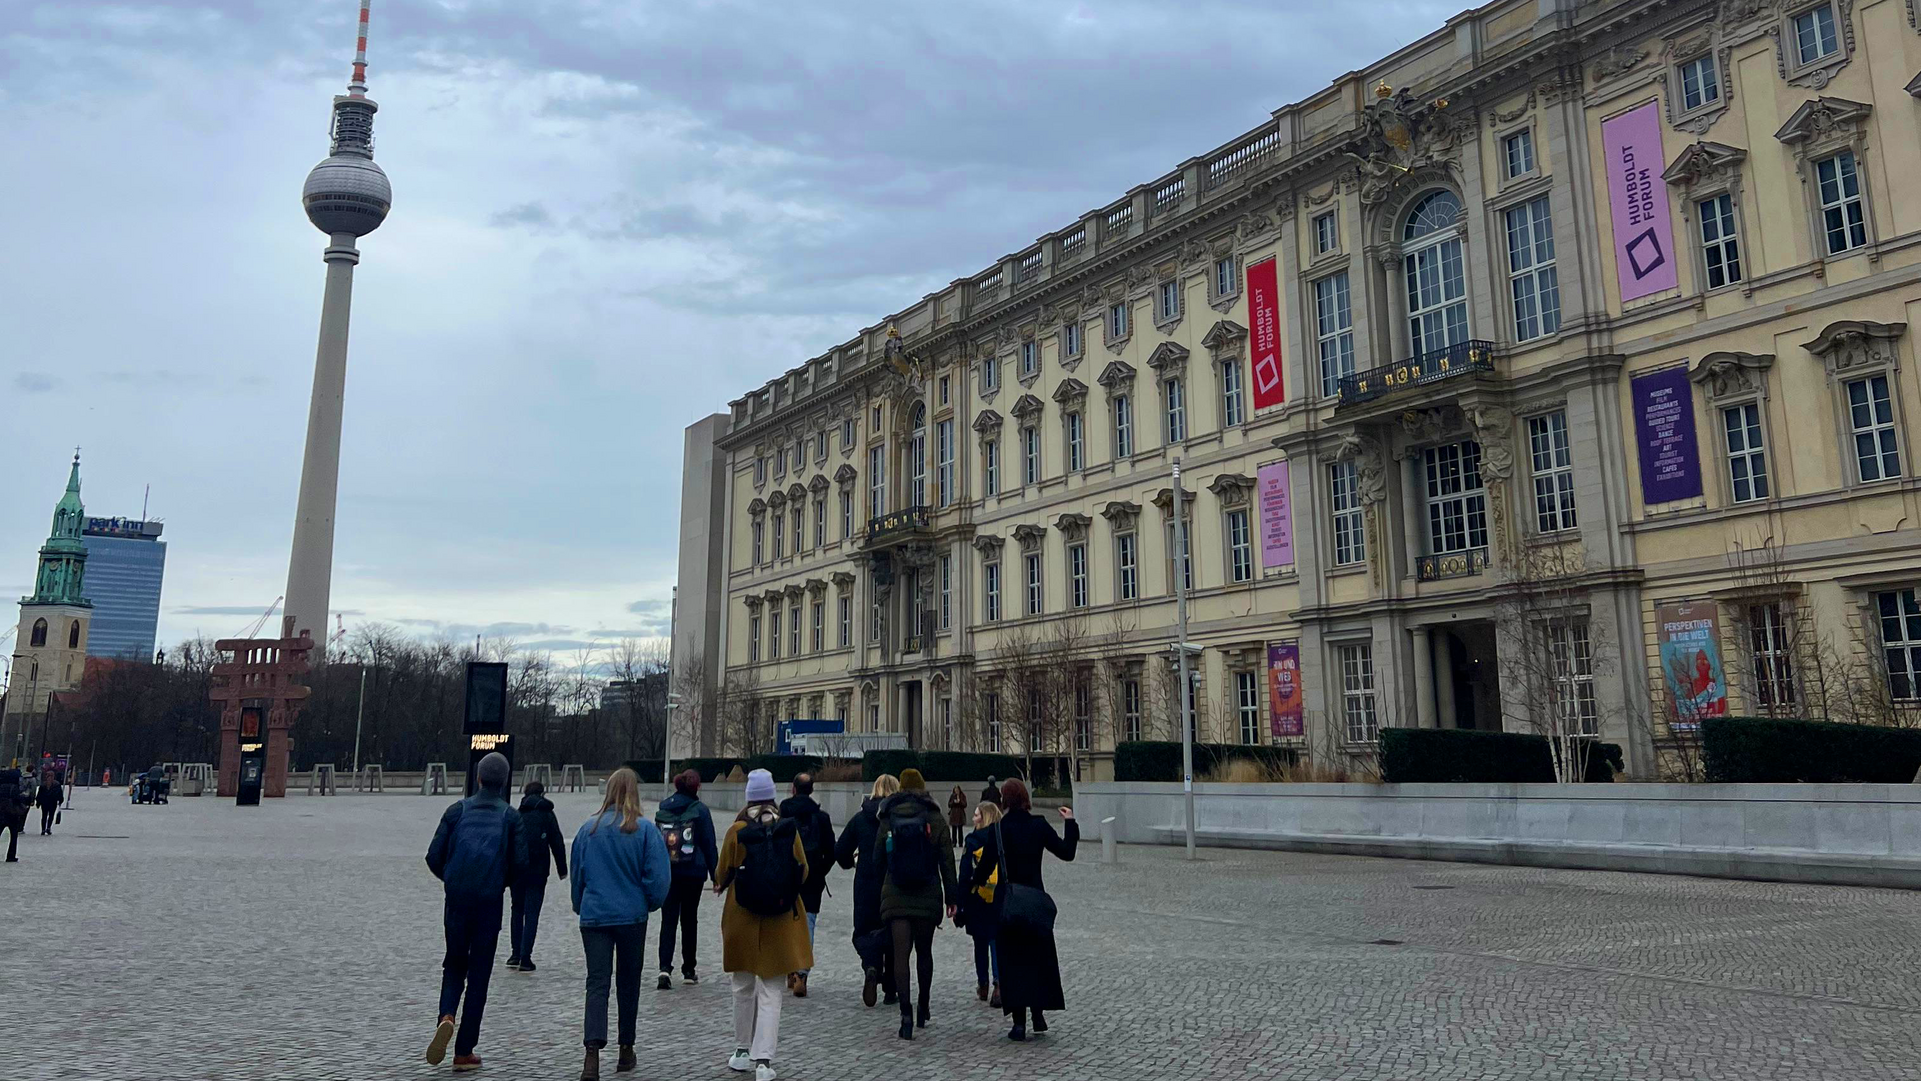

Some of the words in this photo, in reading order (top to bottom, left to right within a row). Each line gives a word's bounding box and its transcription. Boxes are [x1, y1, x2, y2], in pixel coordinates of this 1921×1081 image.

[1622, 145, 1641, 226] HUMBOLDT
[1639, 168, 1655, 221] FORUM
[1255, 288, 1266, 352] HUMBOLDT
[1265, 307, 1274, 349] FORUM
[1658, 429, 1674, 438] DANCE
[1663, 443, 1672, 451] ART
[1663, 619, 1713, 631] PERSPEKTIVEN
[1690, 629, 1709, 640] WELT
[471, 734, 509, 743] HUMBOLDT
[471, 741, 496, 750] FORUM
